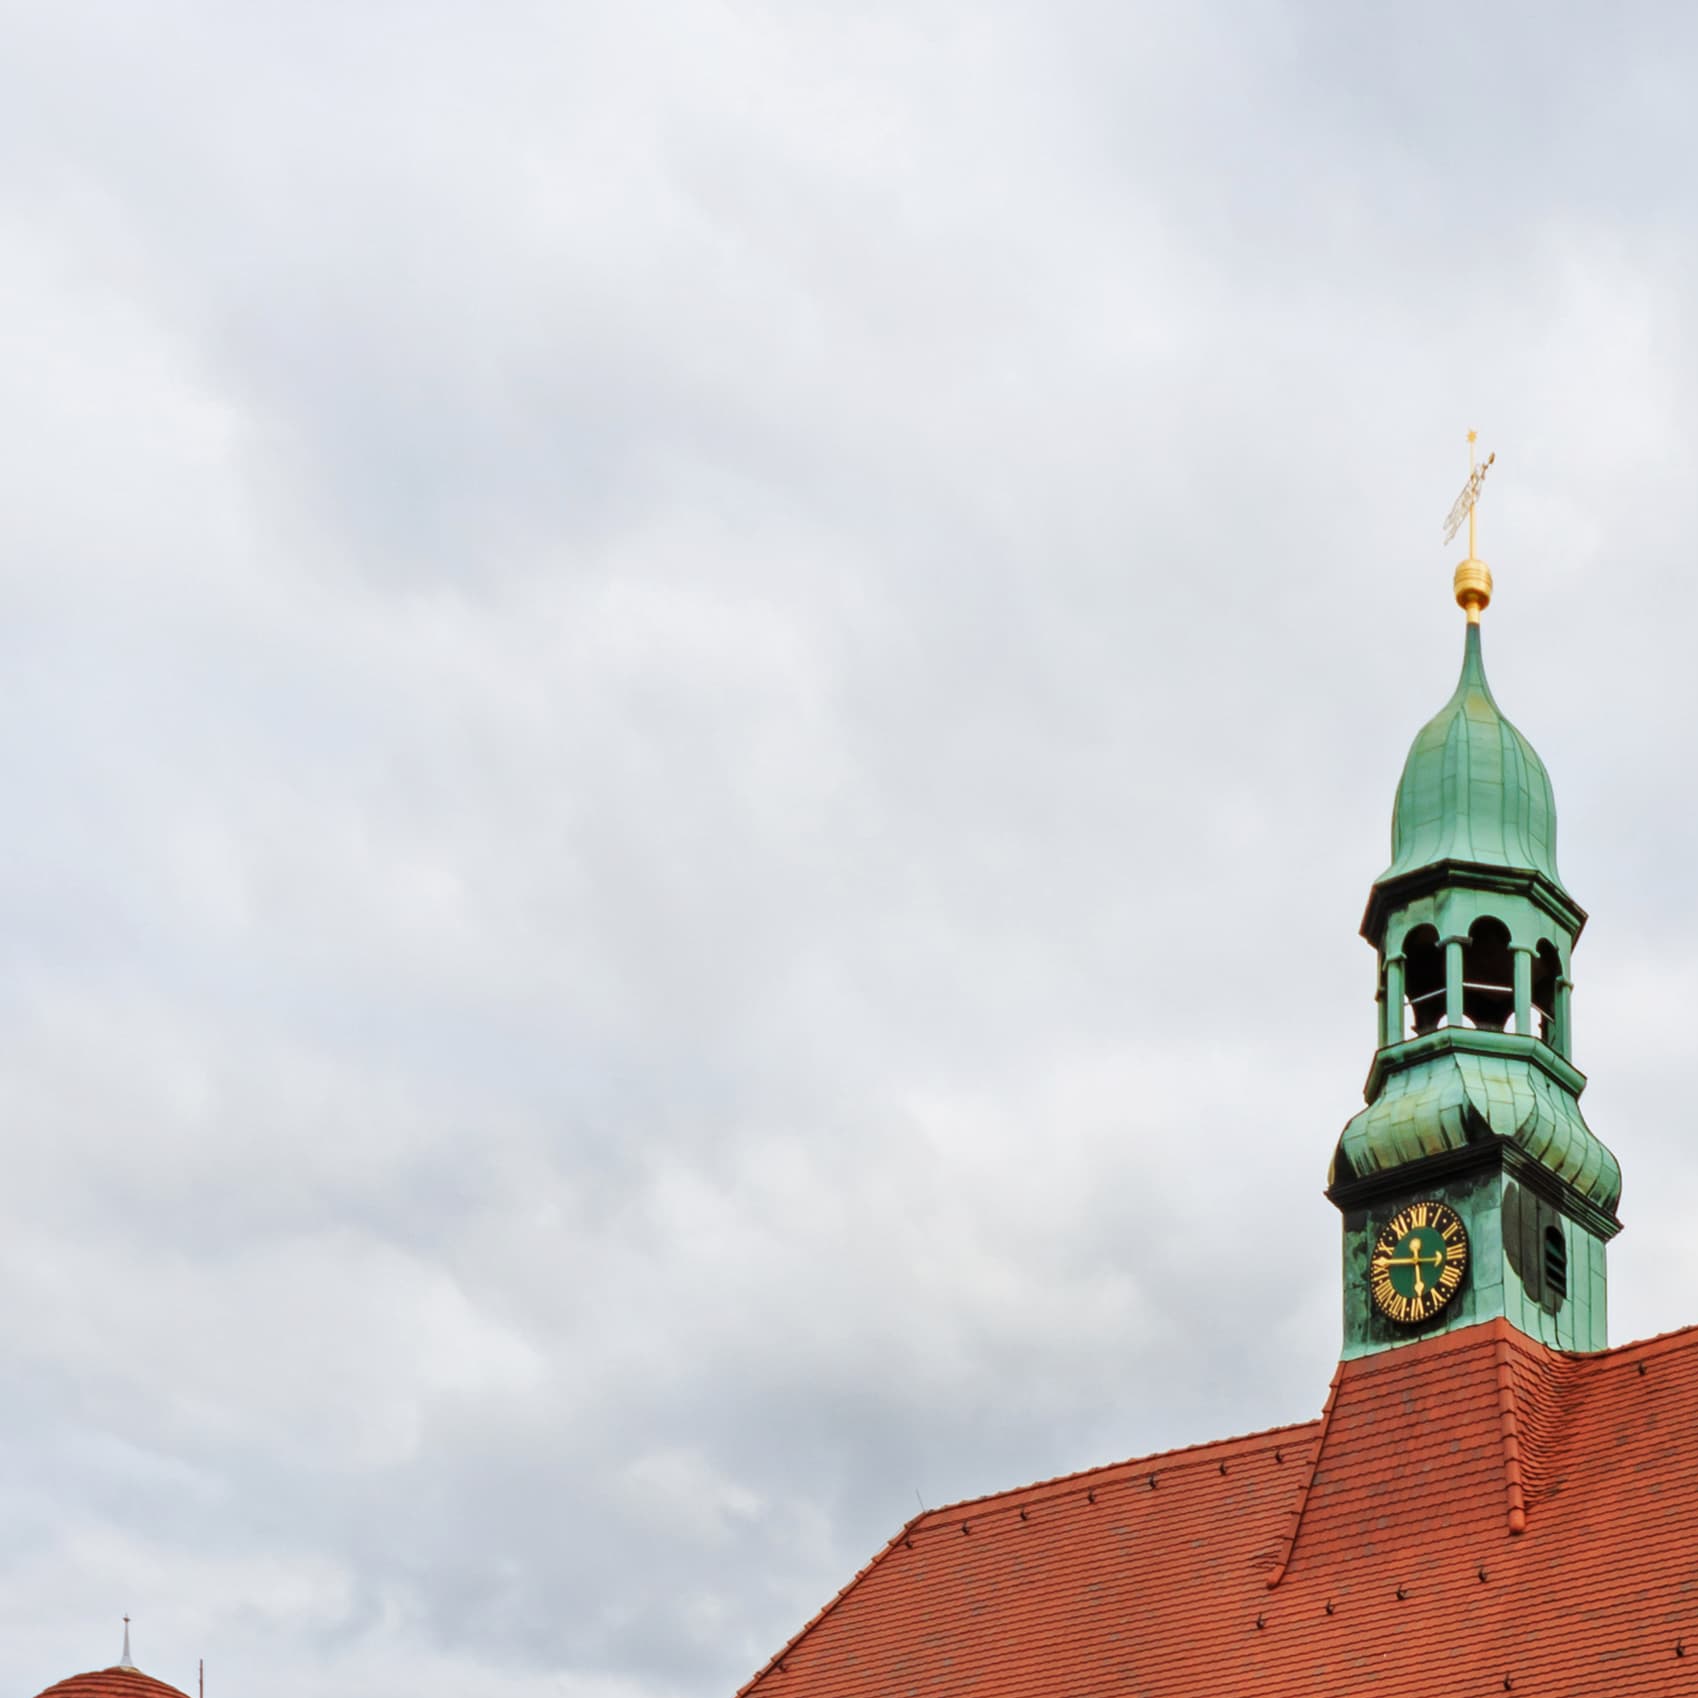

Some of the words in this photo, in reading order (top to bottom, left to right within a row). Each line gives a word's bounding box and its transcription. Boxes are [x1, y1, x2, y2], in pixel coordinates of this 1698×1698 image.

[1391, 1214, 1409, 1240] XI
[1411, 1206, 1427, 1229] XII
[1431, 1207, 1442, 1228] I
[1442, 1221, 1458, 1240] II
[1379, 1239, 1395, 1255] X
[1446, 1242, 1466, 1259] III
[1430, 1288, 1447, 1310] V
